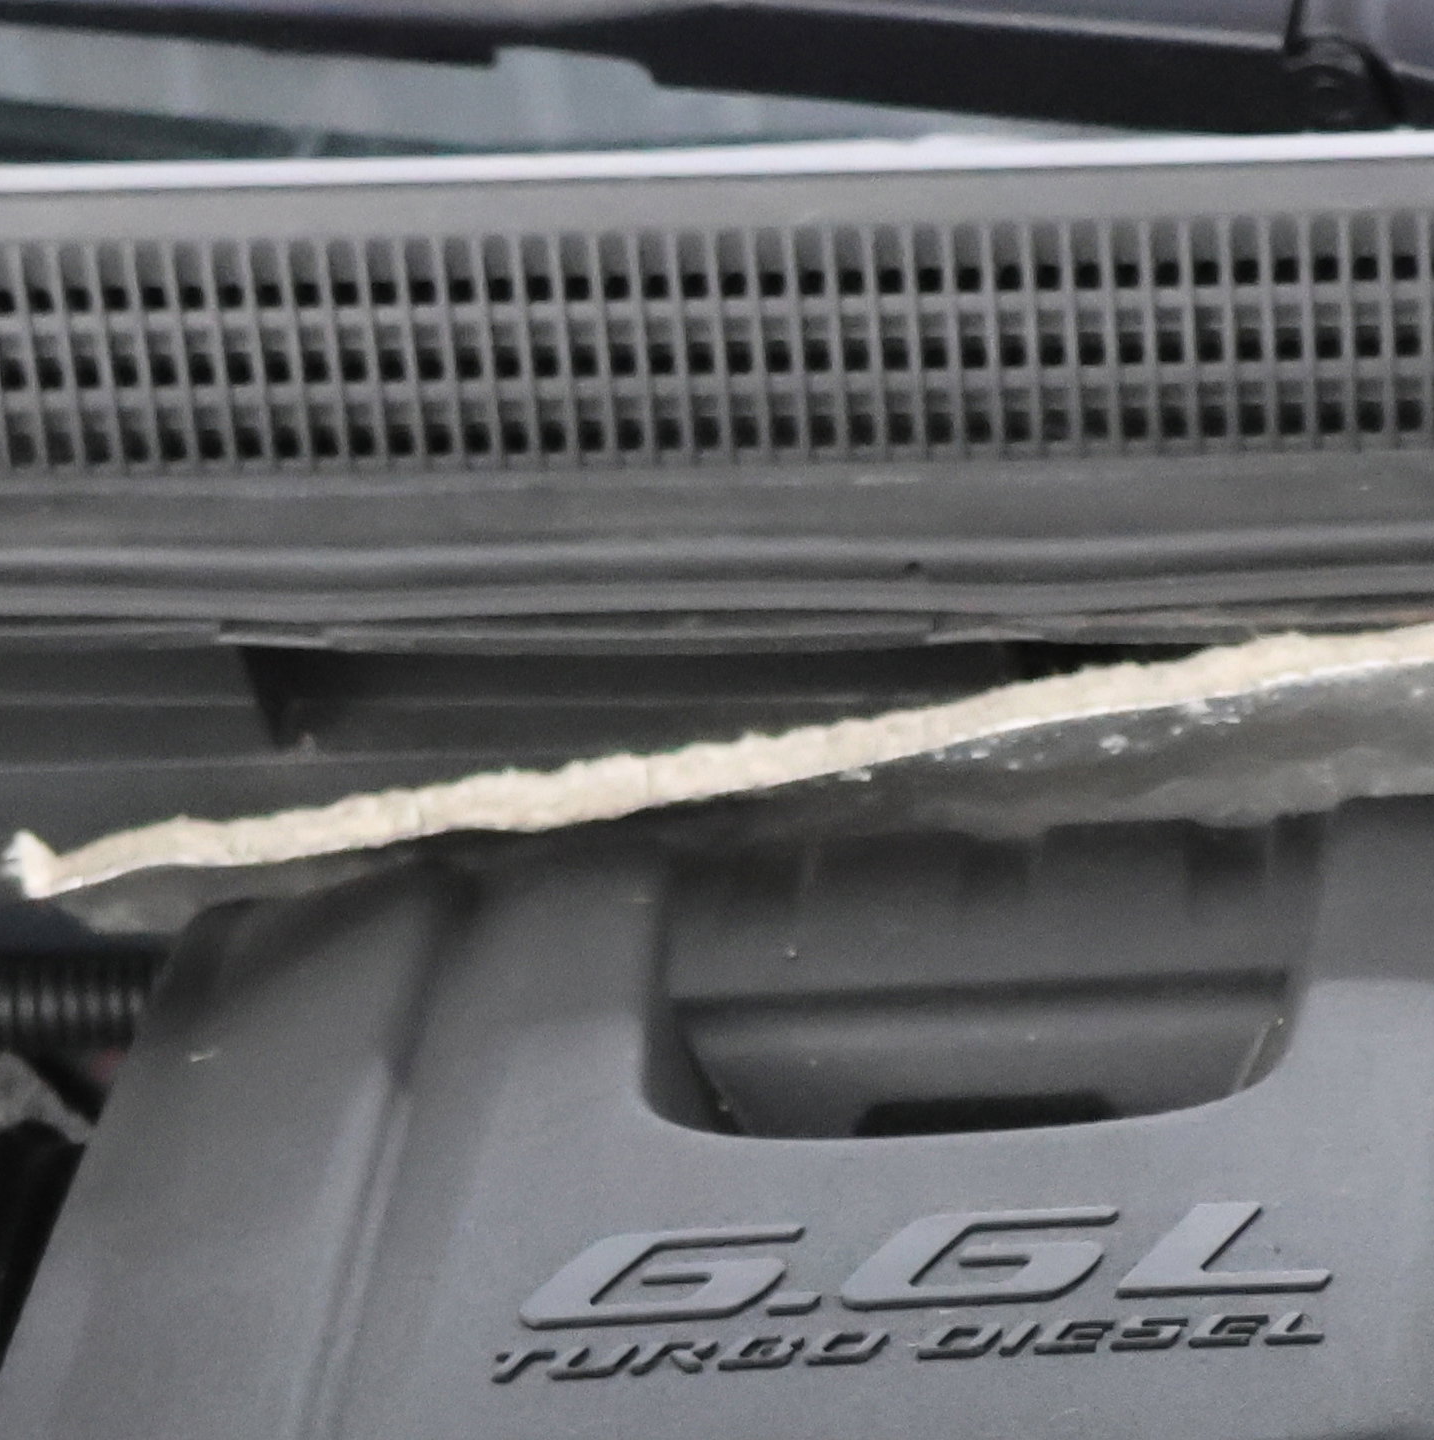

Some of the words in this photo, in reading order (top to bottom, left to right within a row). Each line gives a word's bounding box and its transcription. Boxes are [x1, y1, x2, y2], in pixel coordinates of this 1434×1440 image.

[519, 1201, 1332, 1330] 6.6L
[490, 1327, 891, 1384] TURBO
[916, 1309, 1328, 1361] DIESEL
